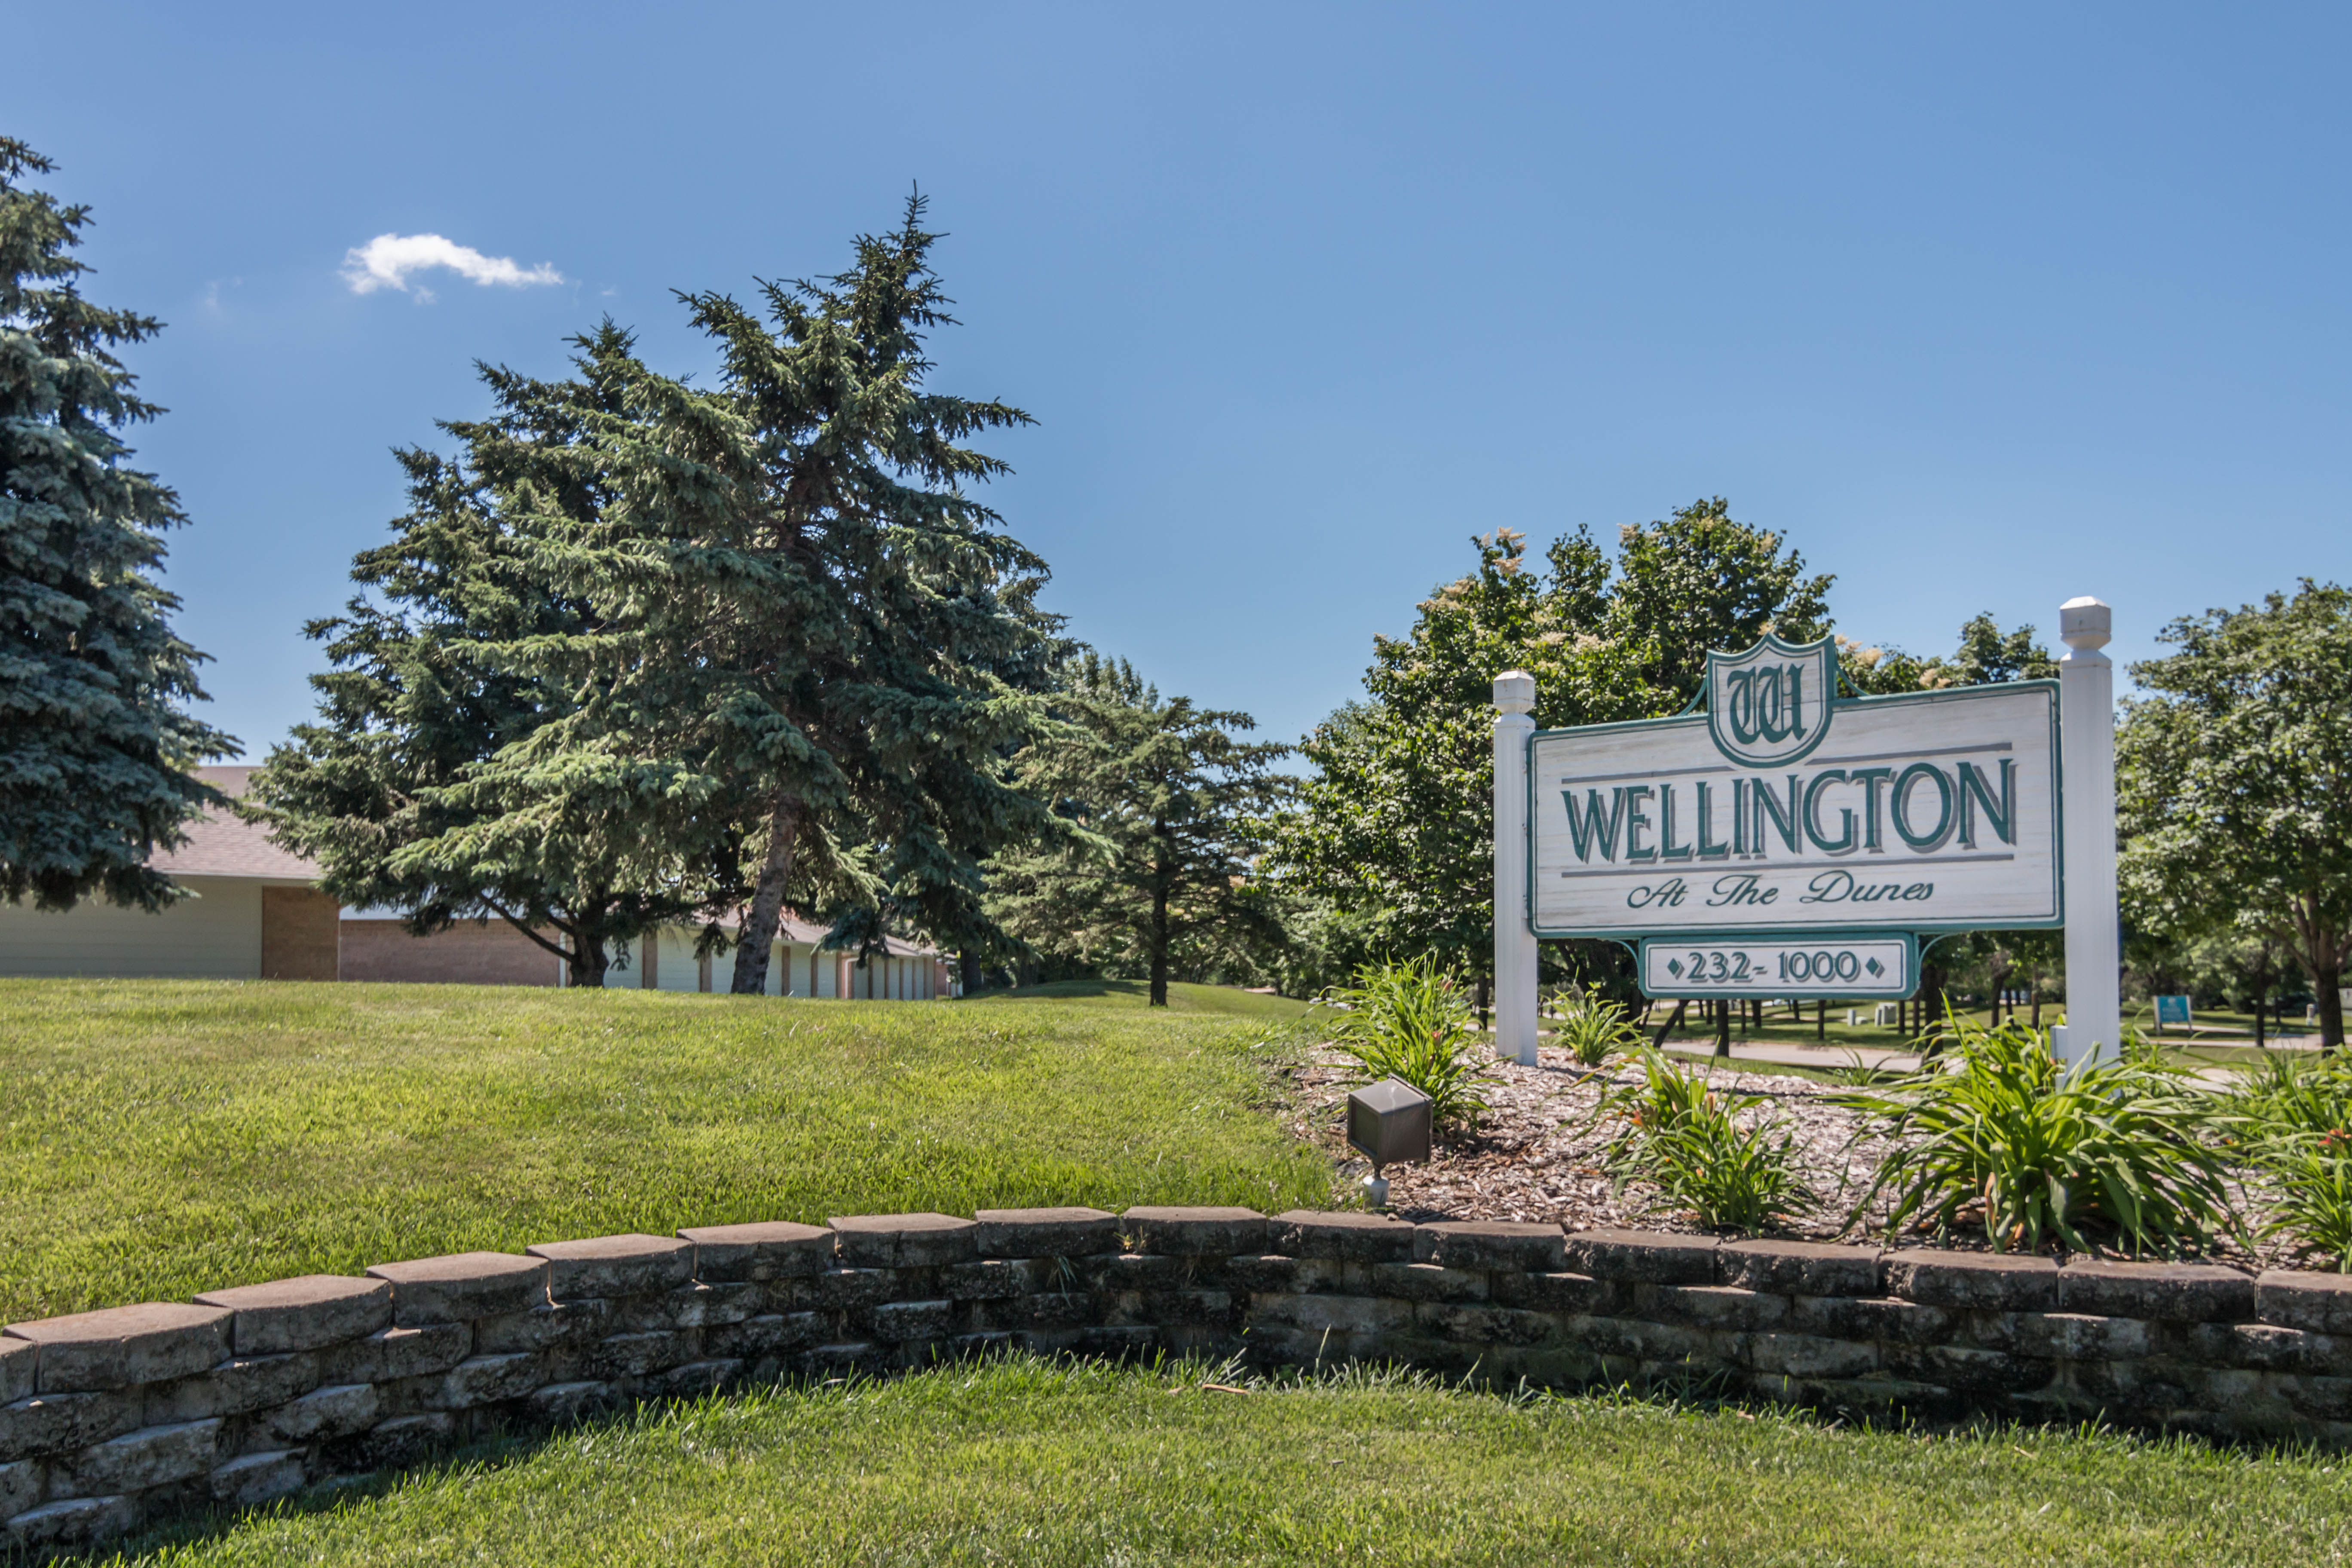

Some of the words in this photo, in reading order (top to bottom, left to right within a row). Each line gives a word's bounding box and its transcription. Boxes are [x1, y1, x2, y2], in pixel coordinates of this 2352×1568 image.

[1727, 662, 1808, 745] W
[1561, 759, 2018, 864] WELLINGTON
[1627, 878, 1688, 909] At
[1706, 874, 1779, 907] The
[1799, 870, 1935, 903] Dunes
